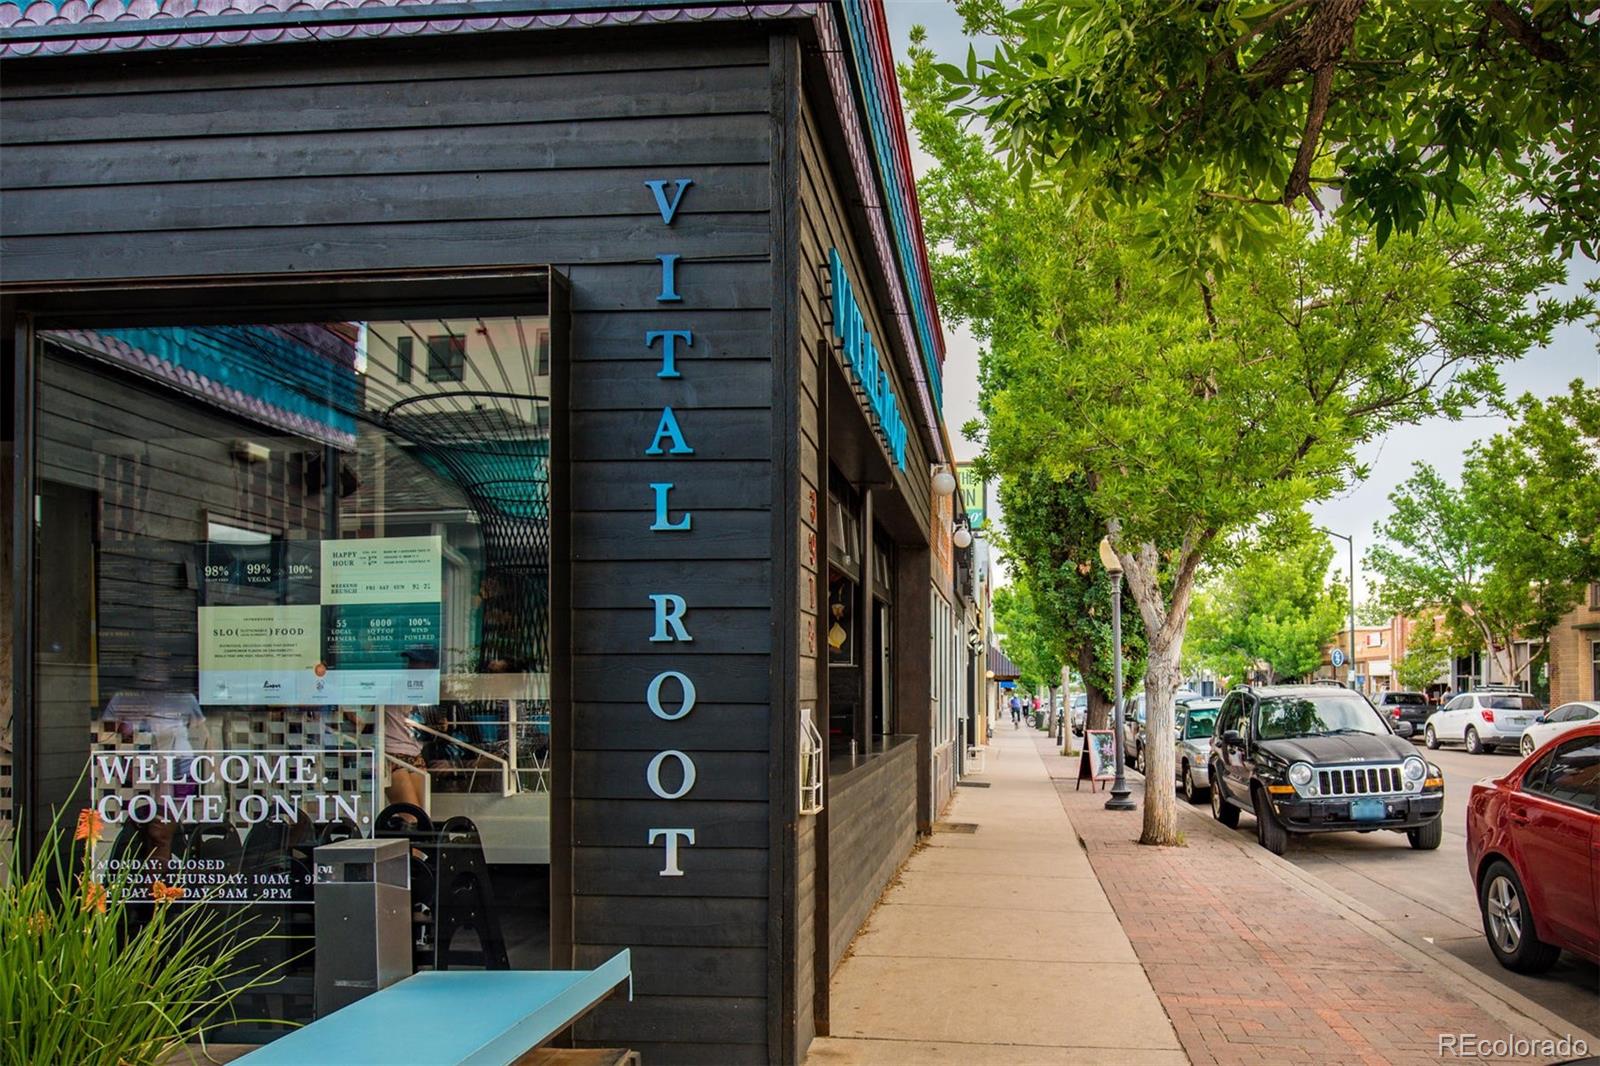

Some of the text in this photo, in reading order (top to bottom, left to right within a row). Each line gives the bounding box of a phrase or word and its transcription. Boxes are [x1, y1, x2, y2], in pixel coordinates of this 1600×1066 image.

[644, 179, 696, 876] VITAL ROOT
[204, 565, 229, 577] 98%
[246, 563, 271, 575] 99%
[288, 564, 313, 574] 100%
[336, 619, 348, 628] 55
[370, 618, 392, 627] 6000
[408, 617, 431, 626] 100%
[97, 755, 329, 785] WELCOME.
[96, 794, 370, 825] COME ON IN.
[96, 859, 225, 871] MONDAY: CLOSED
[253, 873, 290, 885] 10AM
[218, 888, 248, 899] 9AM
[262, 888, 292, 899] 9PM
